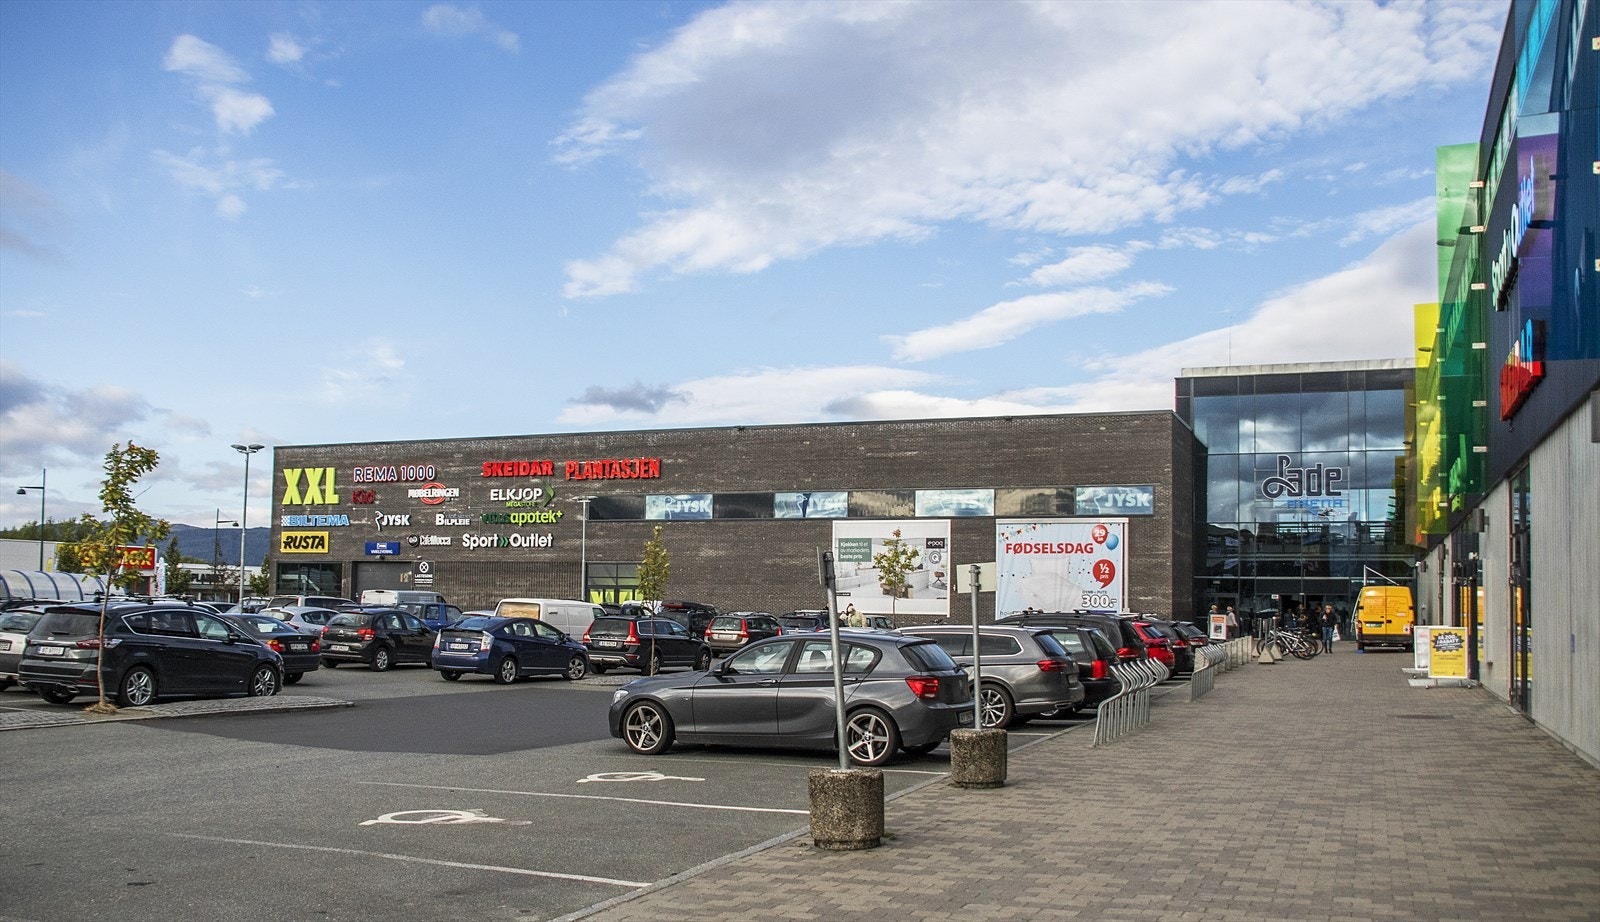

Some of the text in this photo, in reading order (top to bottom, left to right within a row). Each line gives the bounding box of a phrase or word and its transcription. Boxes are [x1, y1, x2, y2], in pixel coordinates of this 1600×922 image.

[353, 464, 435, 483] REMA 1000
[482, 460, 555, 477] SKEIDAR
[565, 458, 661, 481] PLANTASJEN
[1261, 454, 1343, 499] Lade
[281, 467, 340, 505] XXL
[673, 500, 710, 513] JYSK
[1104, 493, 1150, 507] JYSK
[288, 514, 350, 527] BILTEMA
[381, 514, 411, 526] JYSK
[282, 535, 325, 550] RUSTA
[462, 532, 554, 550] Sport Outlet
[1005, 543, 1094, 554] FØDSELSDAG
